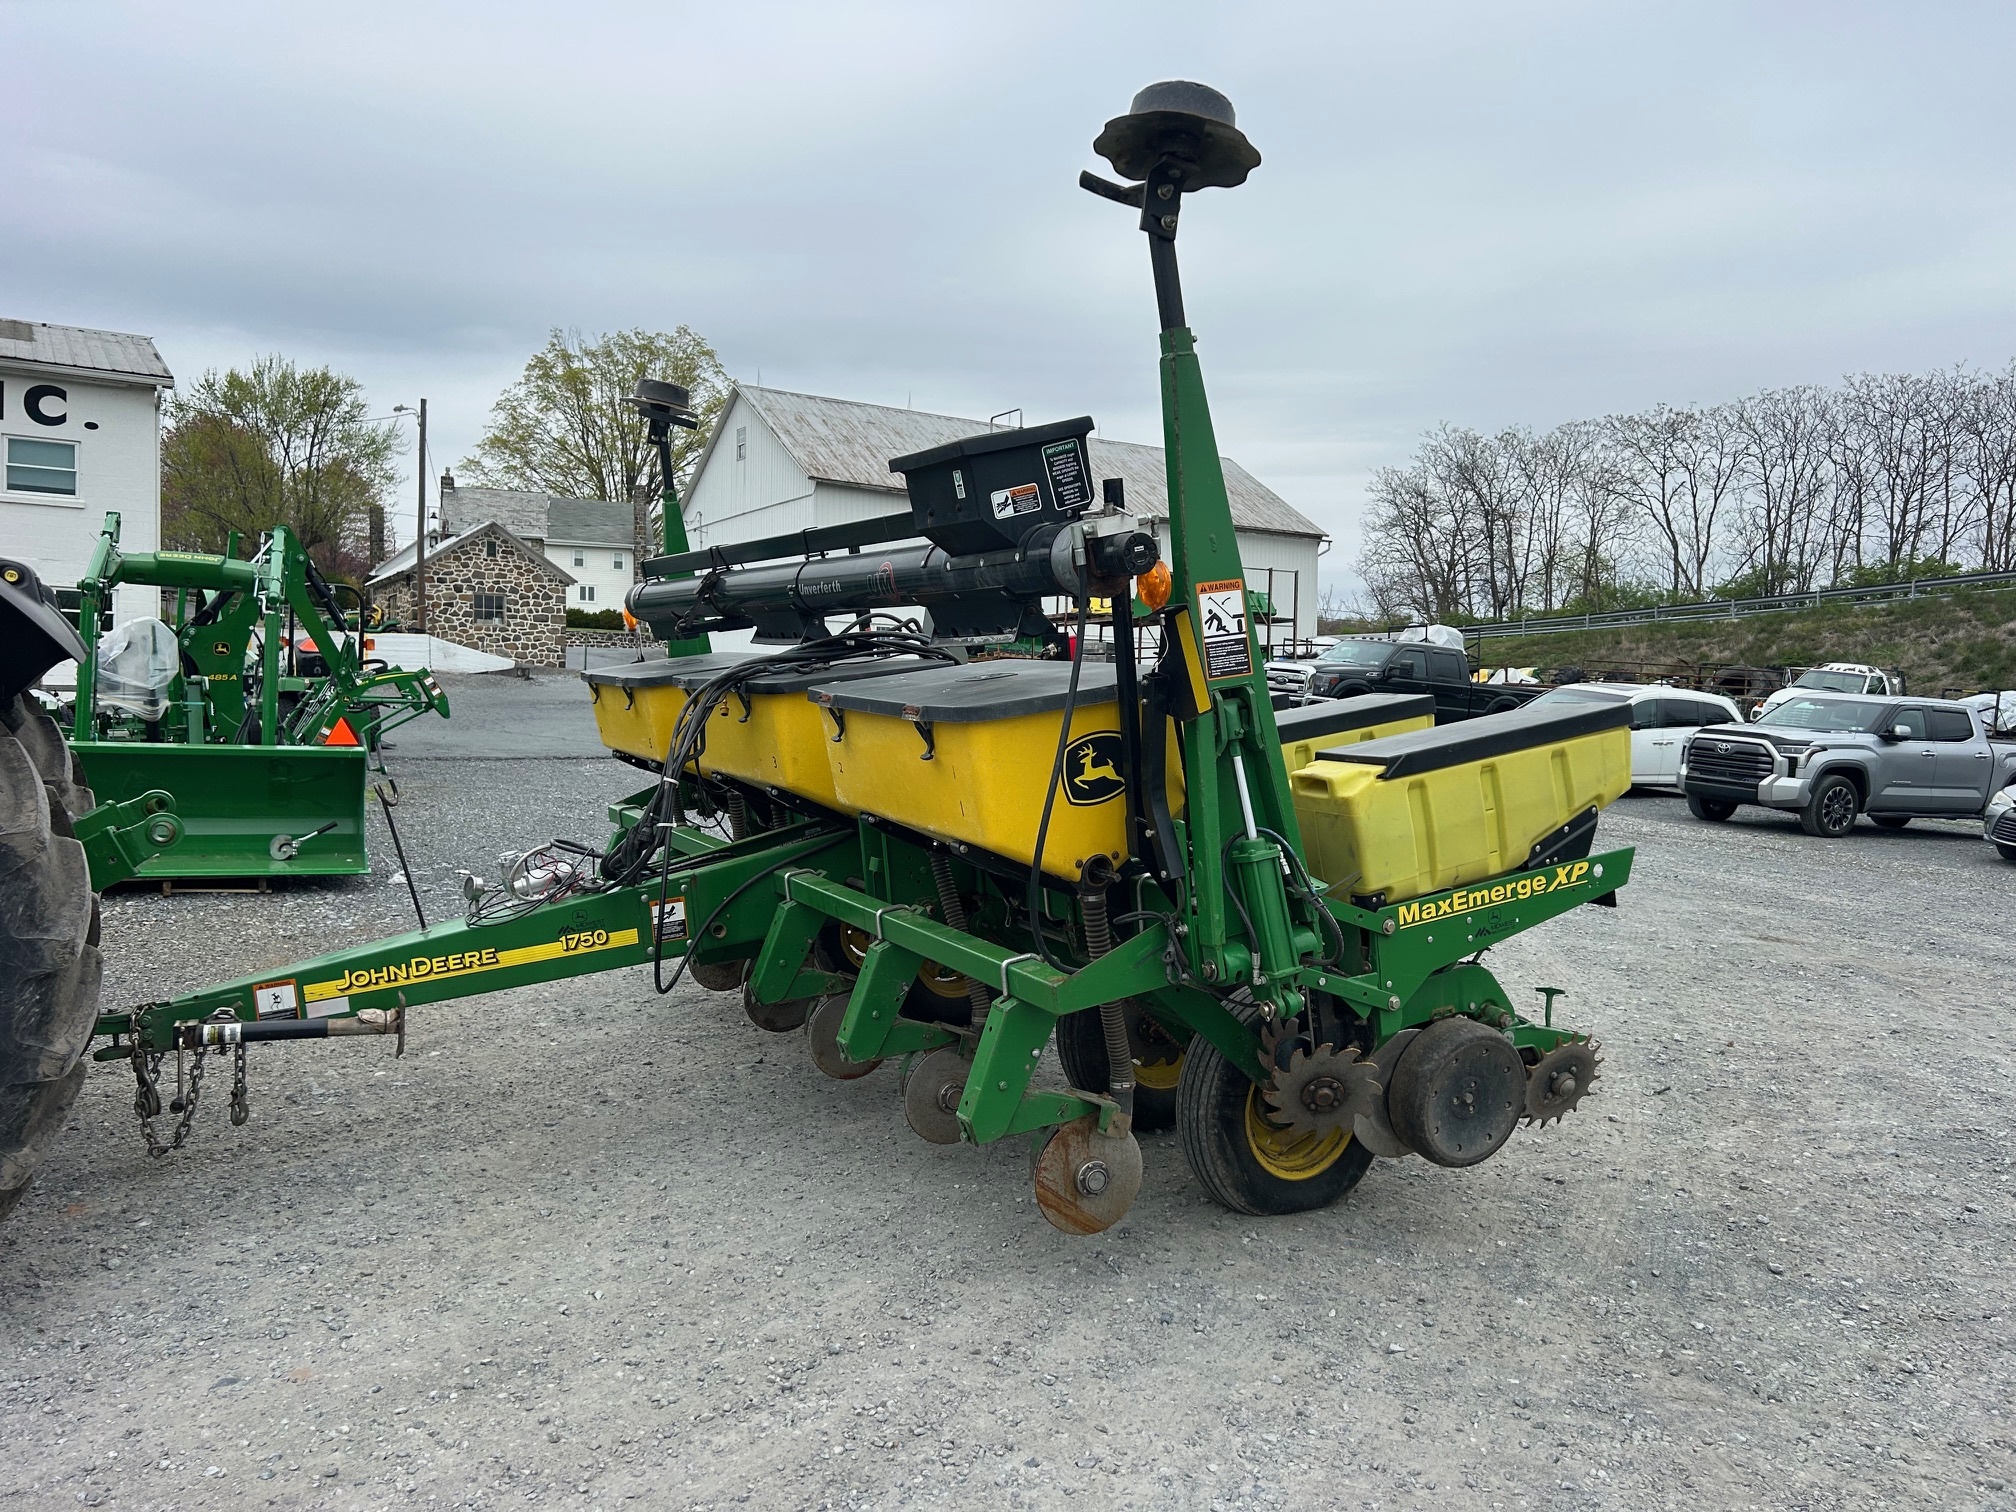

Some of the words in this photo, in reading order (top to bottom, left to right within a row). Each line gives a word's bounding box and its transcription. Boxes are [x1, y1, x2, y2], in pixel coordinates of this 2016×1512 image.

[0, 380, 99, 430] C.
[1046, 442, 1075, 454] IMPORTANT
[798, 580, 842, 596] Unverferth
[1208, 581, 1240, 592] WARNING
[1398, 875, 1548, 926] MaxEmerge
[1547, 861, 1590, 893] XP
[559, 930, 608, 952] 1750
[336, 963, 408, 991] JOHN
[410, 948, 498, 977] DEERE
